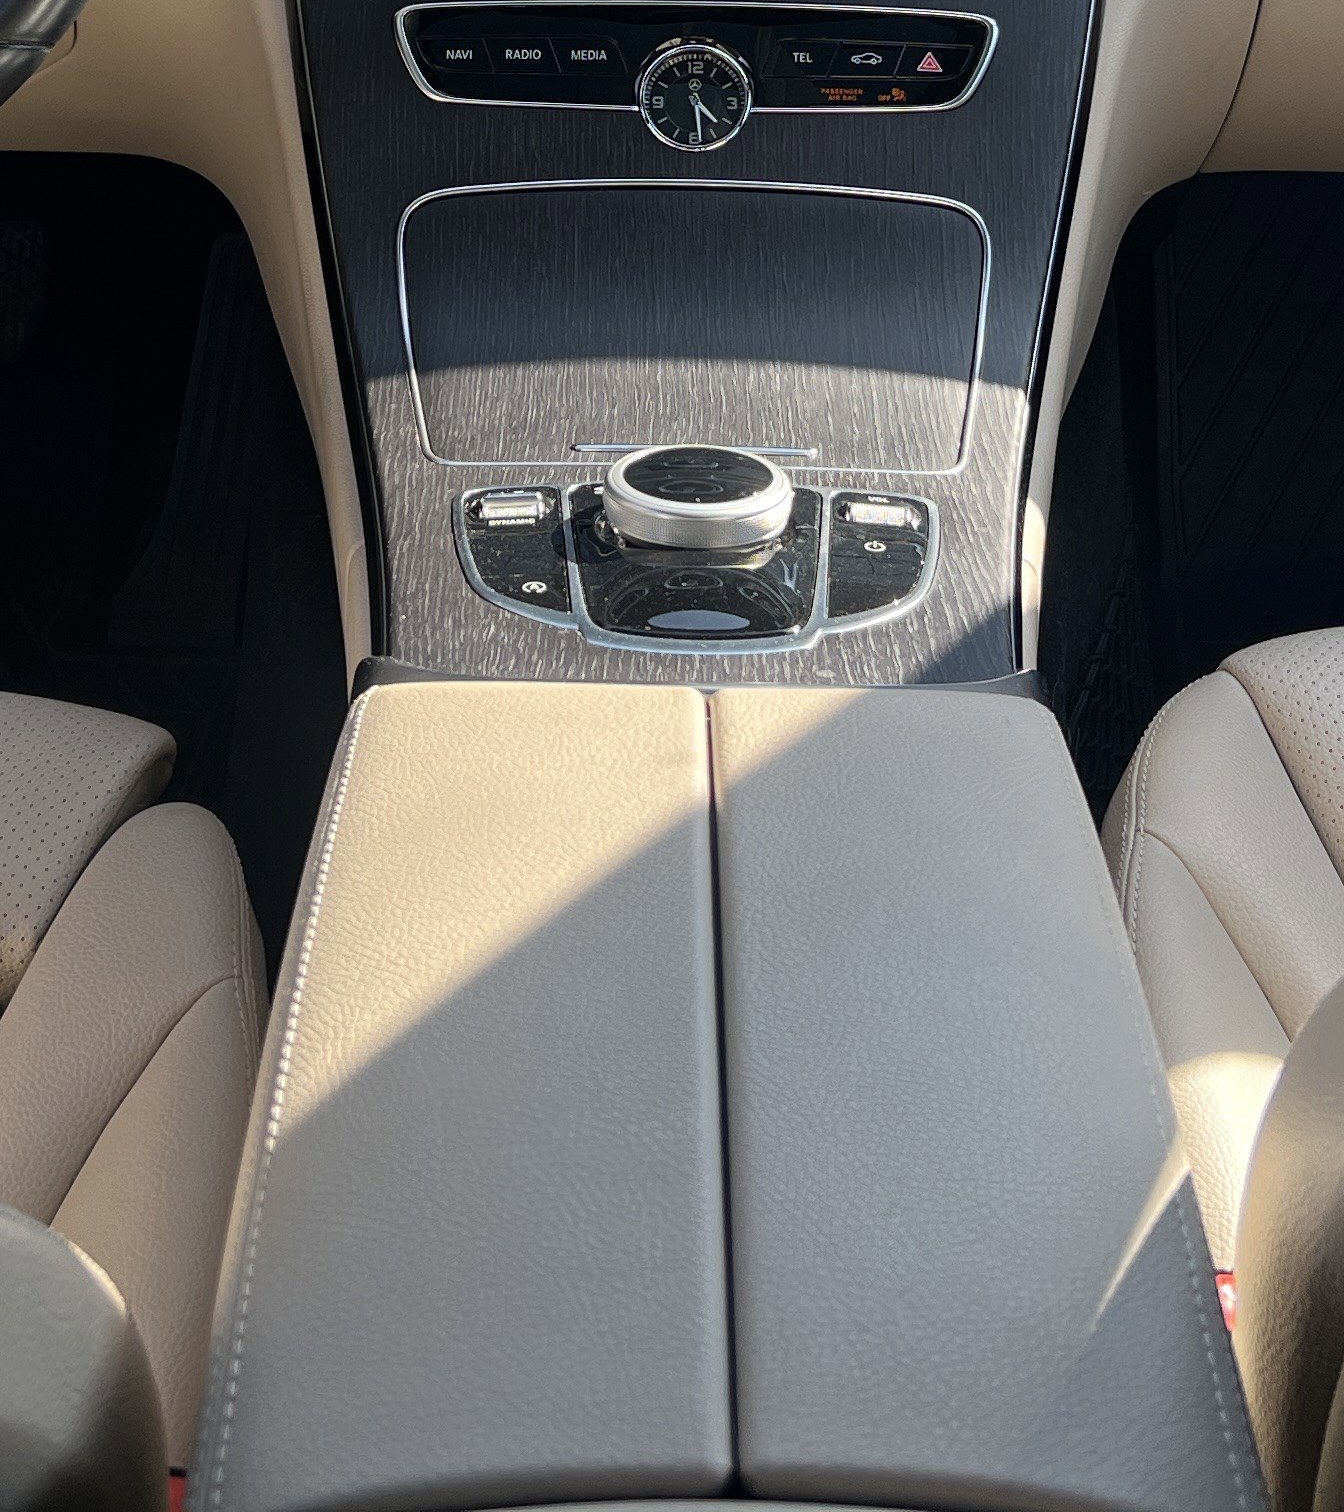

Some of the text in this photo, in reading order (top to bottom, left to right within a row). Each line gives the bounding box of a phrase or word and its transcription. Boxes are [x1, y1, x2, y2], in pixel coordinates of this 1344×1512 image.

[446, 50, 473, 60] NAVI
[505, 50, 541, 60] RADIO
[571, 50, 607, 61] MEDIA
[793, 52, 813, 63] TEL
[687, 61, 704, 75] 12
[652, 96, 664, 109] 9
[727, 96, 738, 110] 3
[488, 518, 536, 526] DYNAMIC
